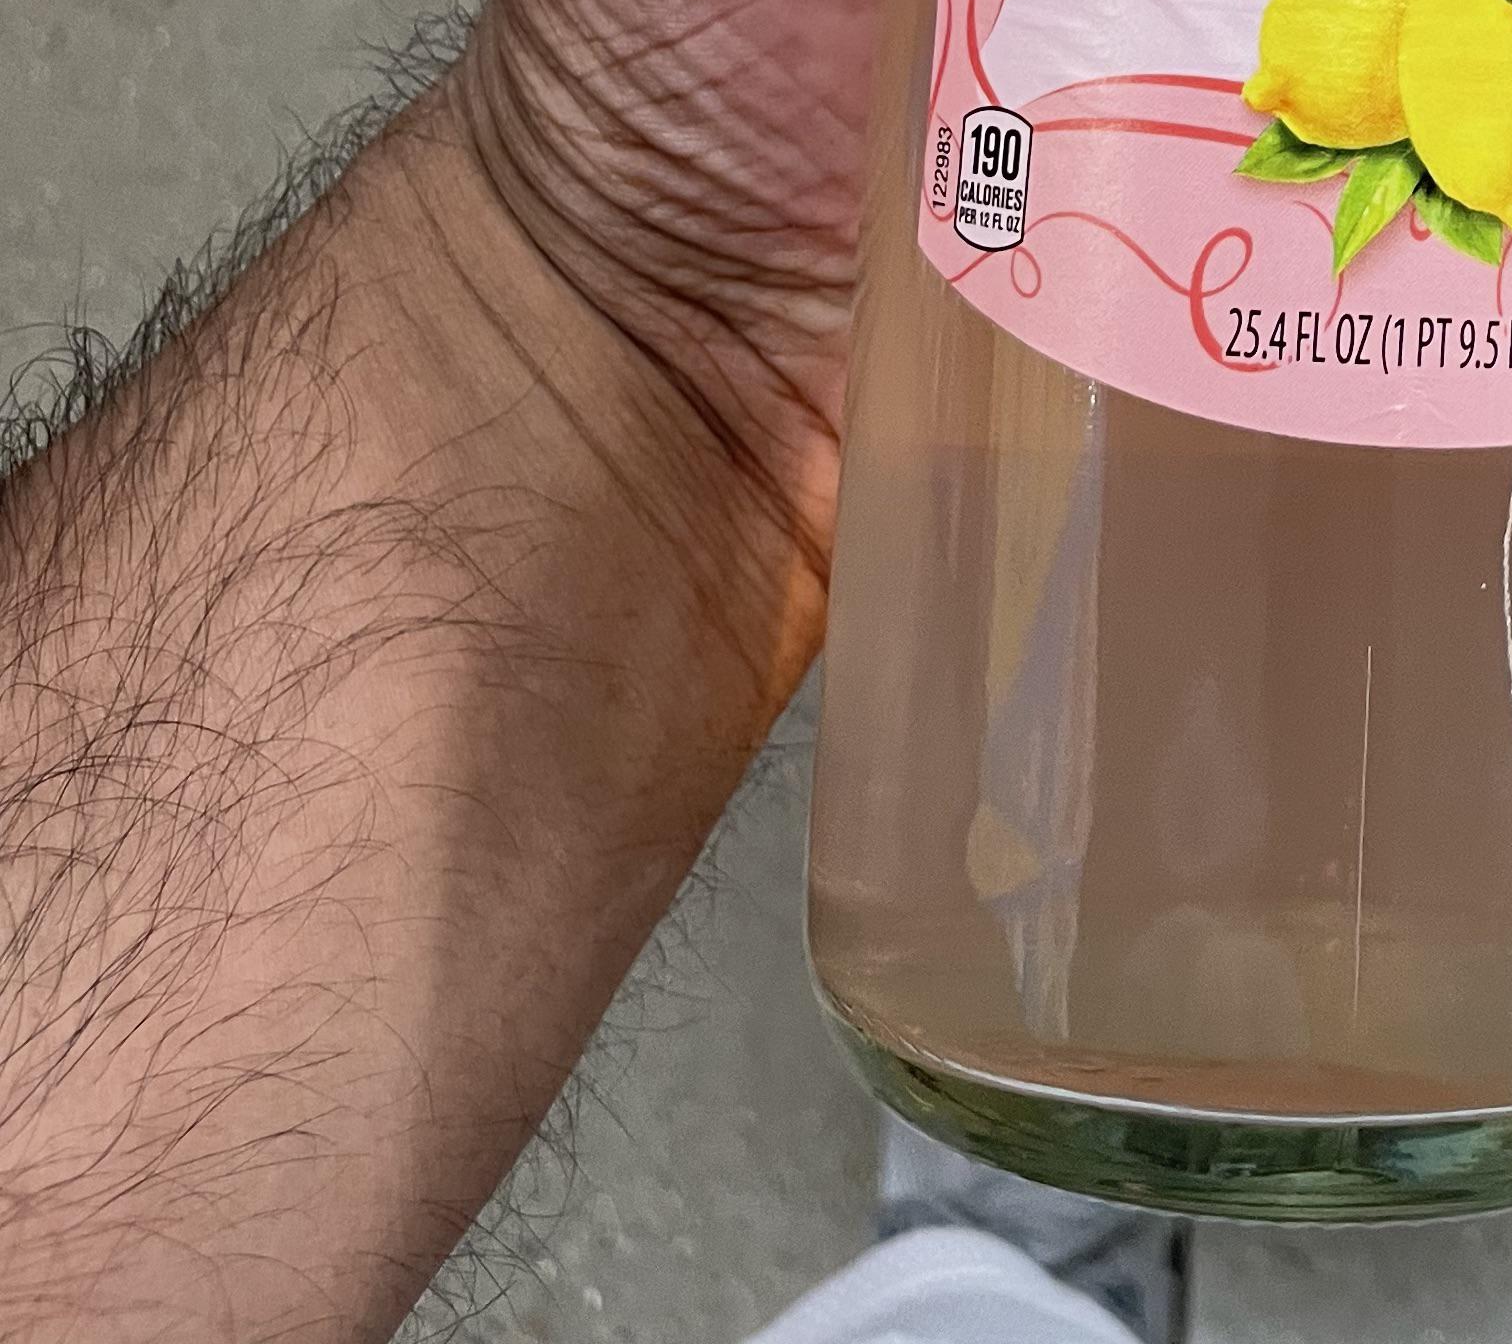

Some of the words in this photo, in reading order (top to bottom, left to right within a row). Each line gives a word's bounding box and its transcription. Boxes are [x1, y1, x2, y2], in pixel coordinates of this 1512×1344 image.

[932, 126, 953, 209] 122983
[970, 123, 1022, 181] 190
[958, 206, 977, 225] PER
[979, 210, 991, 228] 12
[992, 212, 1004, 231] FL
[1006, 215, 1021, 234] OZ
[960, 179, 1024, 212] CALORIES
[1225, 307, 1287, 361] 25.4
[1295, 311, 1326, 364] FL
[1335, 313, 1374, 366] OZ
[1381, 314, 1406, 375] (1
[1416, 317, 1453, 368] PT
[1459, 319, 1500, 370] 9.5
